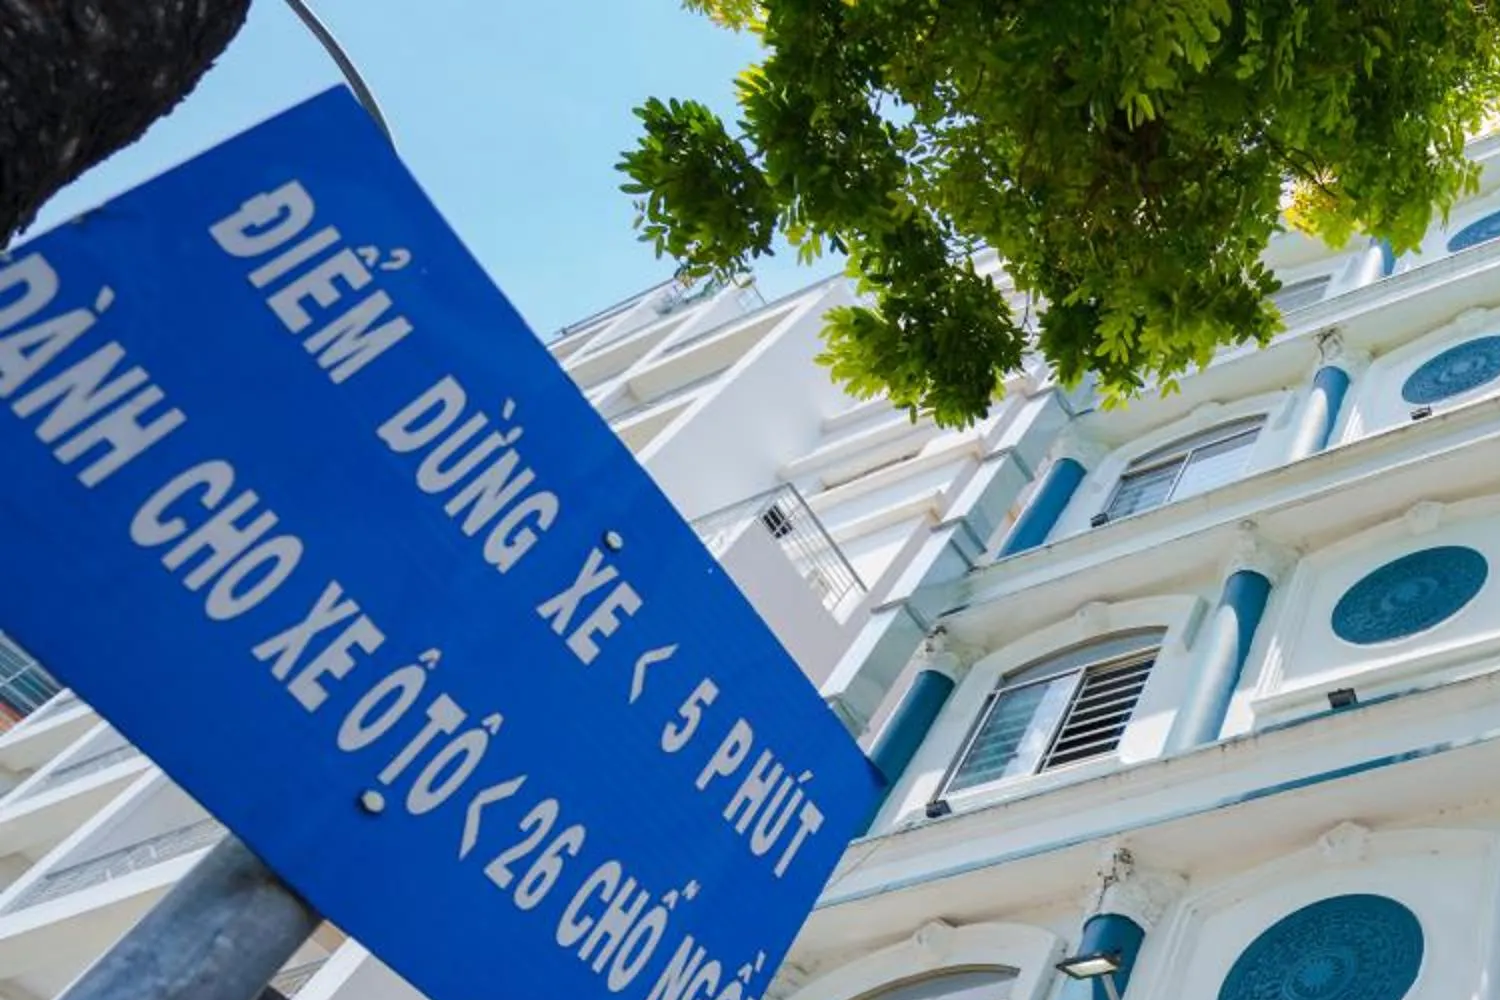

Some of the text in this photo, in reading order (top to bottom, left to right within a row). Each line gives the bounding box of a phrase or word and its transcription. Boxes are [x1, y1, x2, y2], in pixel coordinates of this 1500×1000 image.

[0, 252, 187, 488] DÀNH
[130, 460, 303, 620] CHO
[252, 579, 386, 713] XE
[484, 798, 586, 910] 26
[556, 860, 701, 992] CHỖ
[209, 180, 413, 384] ĐIỂM
[378, 374, 558, 574] DỪNG
[537, 547, 642, 665] XE
[661, 678, 719, 752] 5
[696, 717, 824, 877] PHÚT
